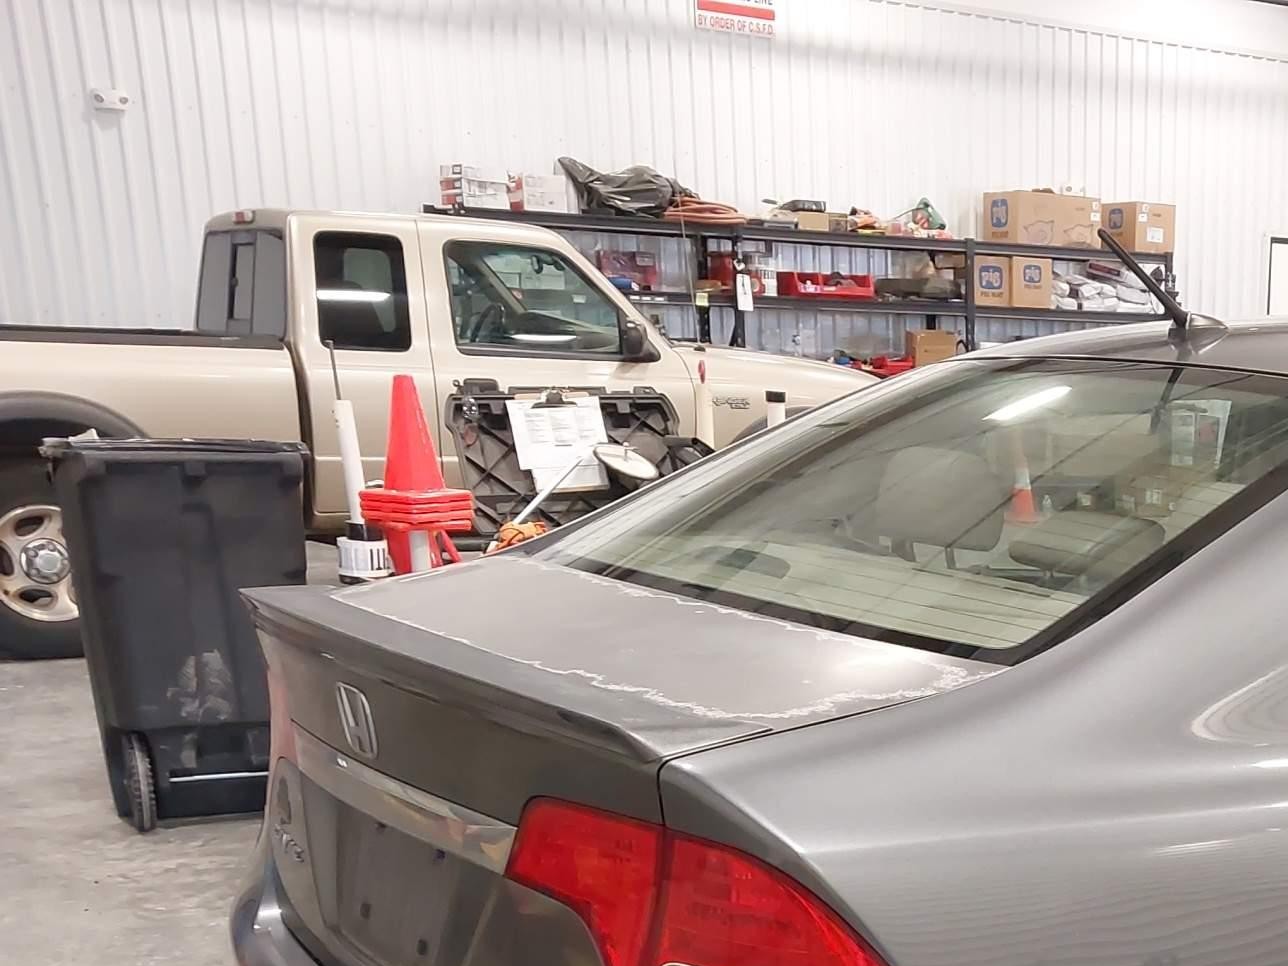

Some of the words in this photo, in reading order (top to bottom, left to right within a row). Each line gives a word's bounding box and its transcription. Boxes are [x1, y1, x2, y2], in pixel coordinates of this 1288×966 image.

[698, 14, 707, 25] BY
[710, 16, 735, 31] ORDER
[737, 20, 747, 32] OF
